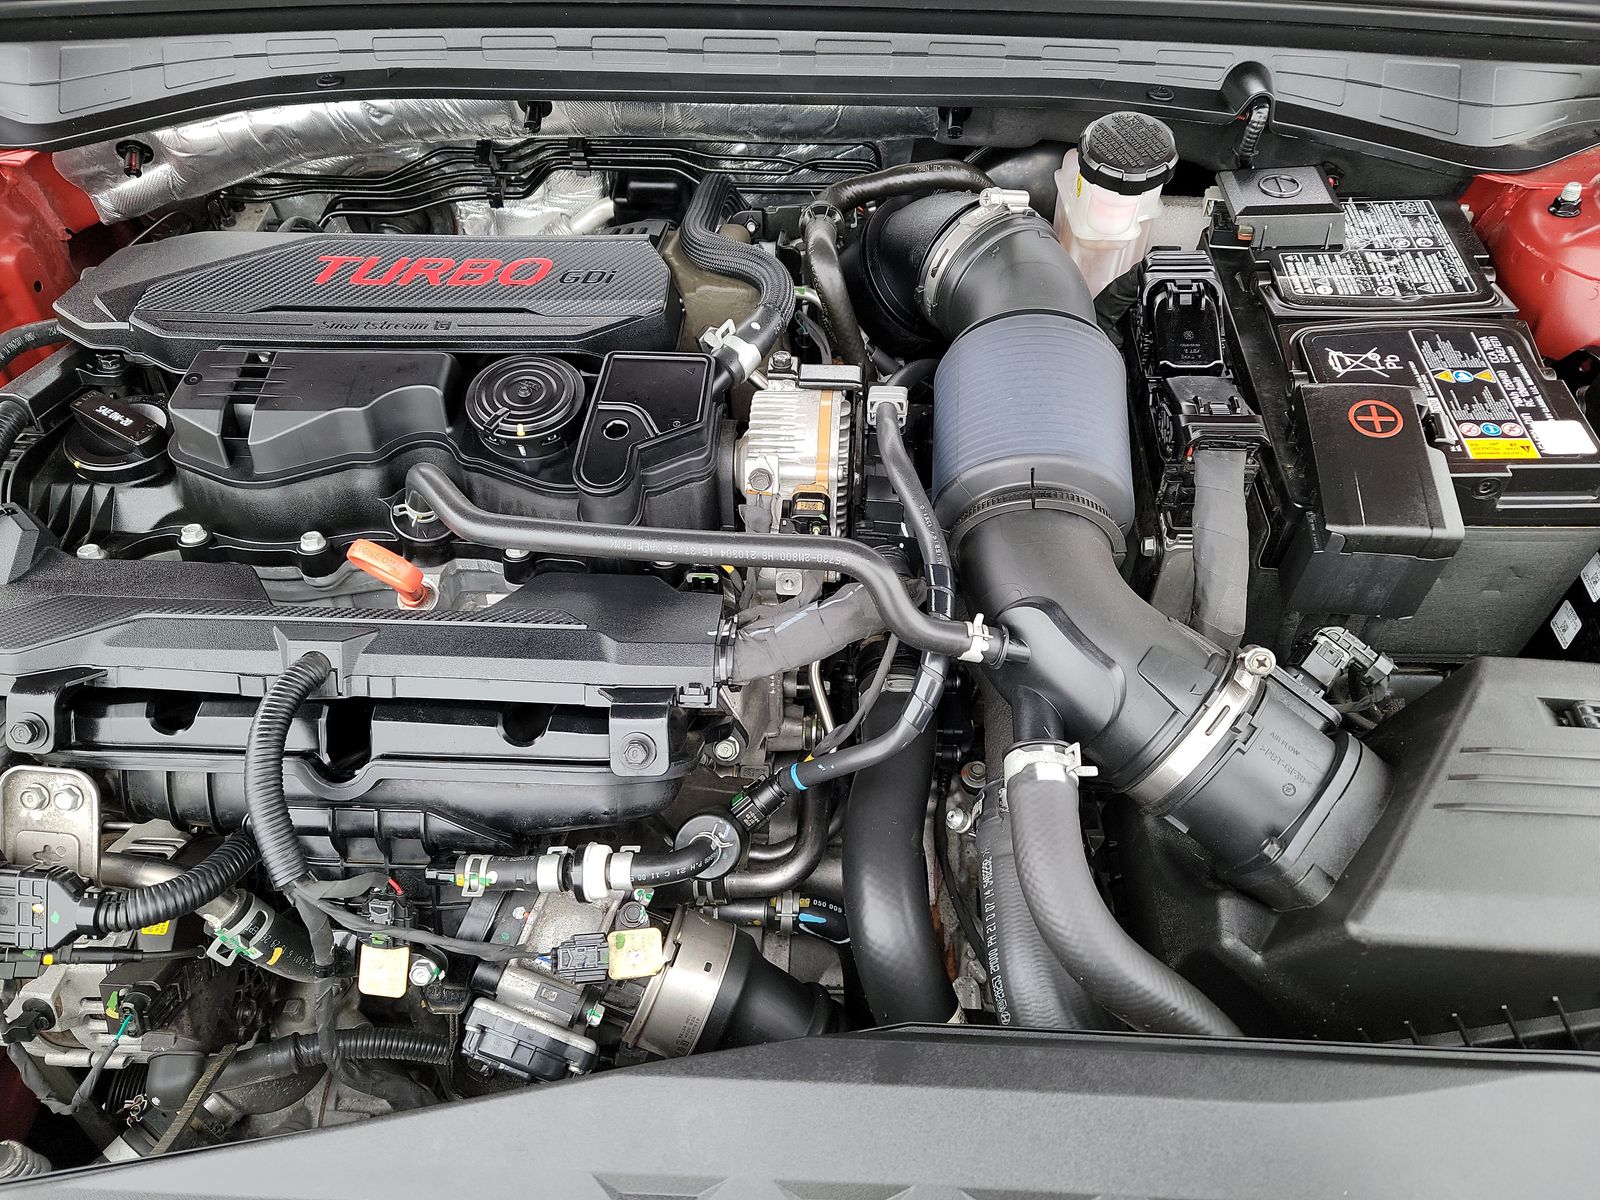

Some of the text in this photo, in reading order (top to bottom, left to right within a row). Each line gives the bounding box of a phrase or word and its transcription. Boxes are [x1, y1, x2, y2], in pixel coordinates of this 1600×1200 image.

[314, 254, 618, 287] TURBO GDi
[318, 320, 429, 331] Smartstream
[1384, 354, 1404, 370] Pb
[1487, 350, 1501, 364] CCA
[1496, 370, 1526, 408] 70Ah (20HR)
[1525, 395, 1536, 408] RC
[94, 404, 135, 427] SAE 0W-20
[720, 549, 757, 562] 210304
[761, 551, 774, 563] HS
[1270, 731, 1300, 756] AIR FLOW
[651, 872, 660, 880] 11
[676, 866, 687, 875] 21
[813, 898, 827, 908] 050
[984, 902, 995, 912] 07
[985, 922, 996, 932] 21
[986, 935, 997, 947] PH
